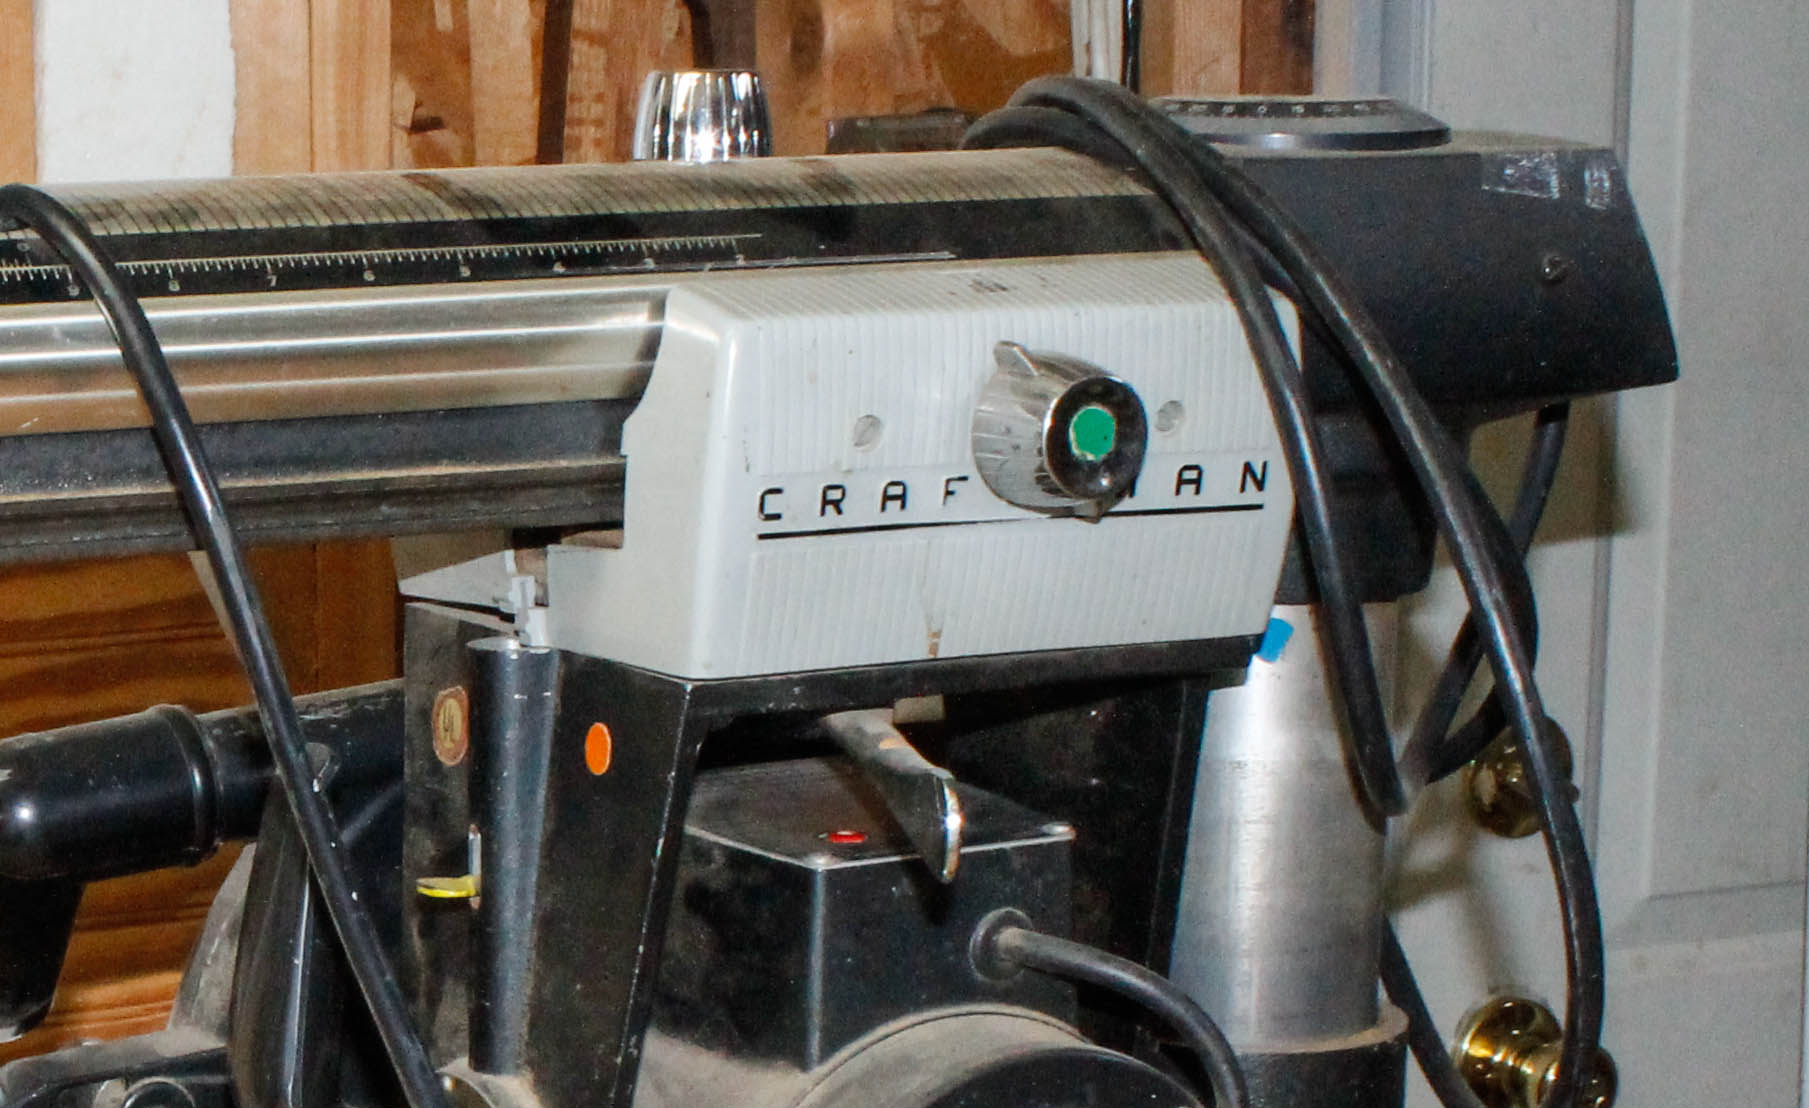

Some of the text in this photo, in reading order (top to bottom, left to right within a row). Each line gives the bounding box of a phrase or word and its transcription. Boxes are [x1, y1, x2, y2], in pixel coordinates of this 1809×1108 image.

[67, 285, 81, 297] 9
[266, 275, 277, 287] 7
[758, 460, 1268, 521] CRAFAN
